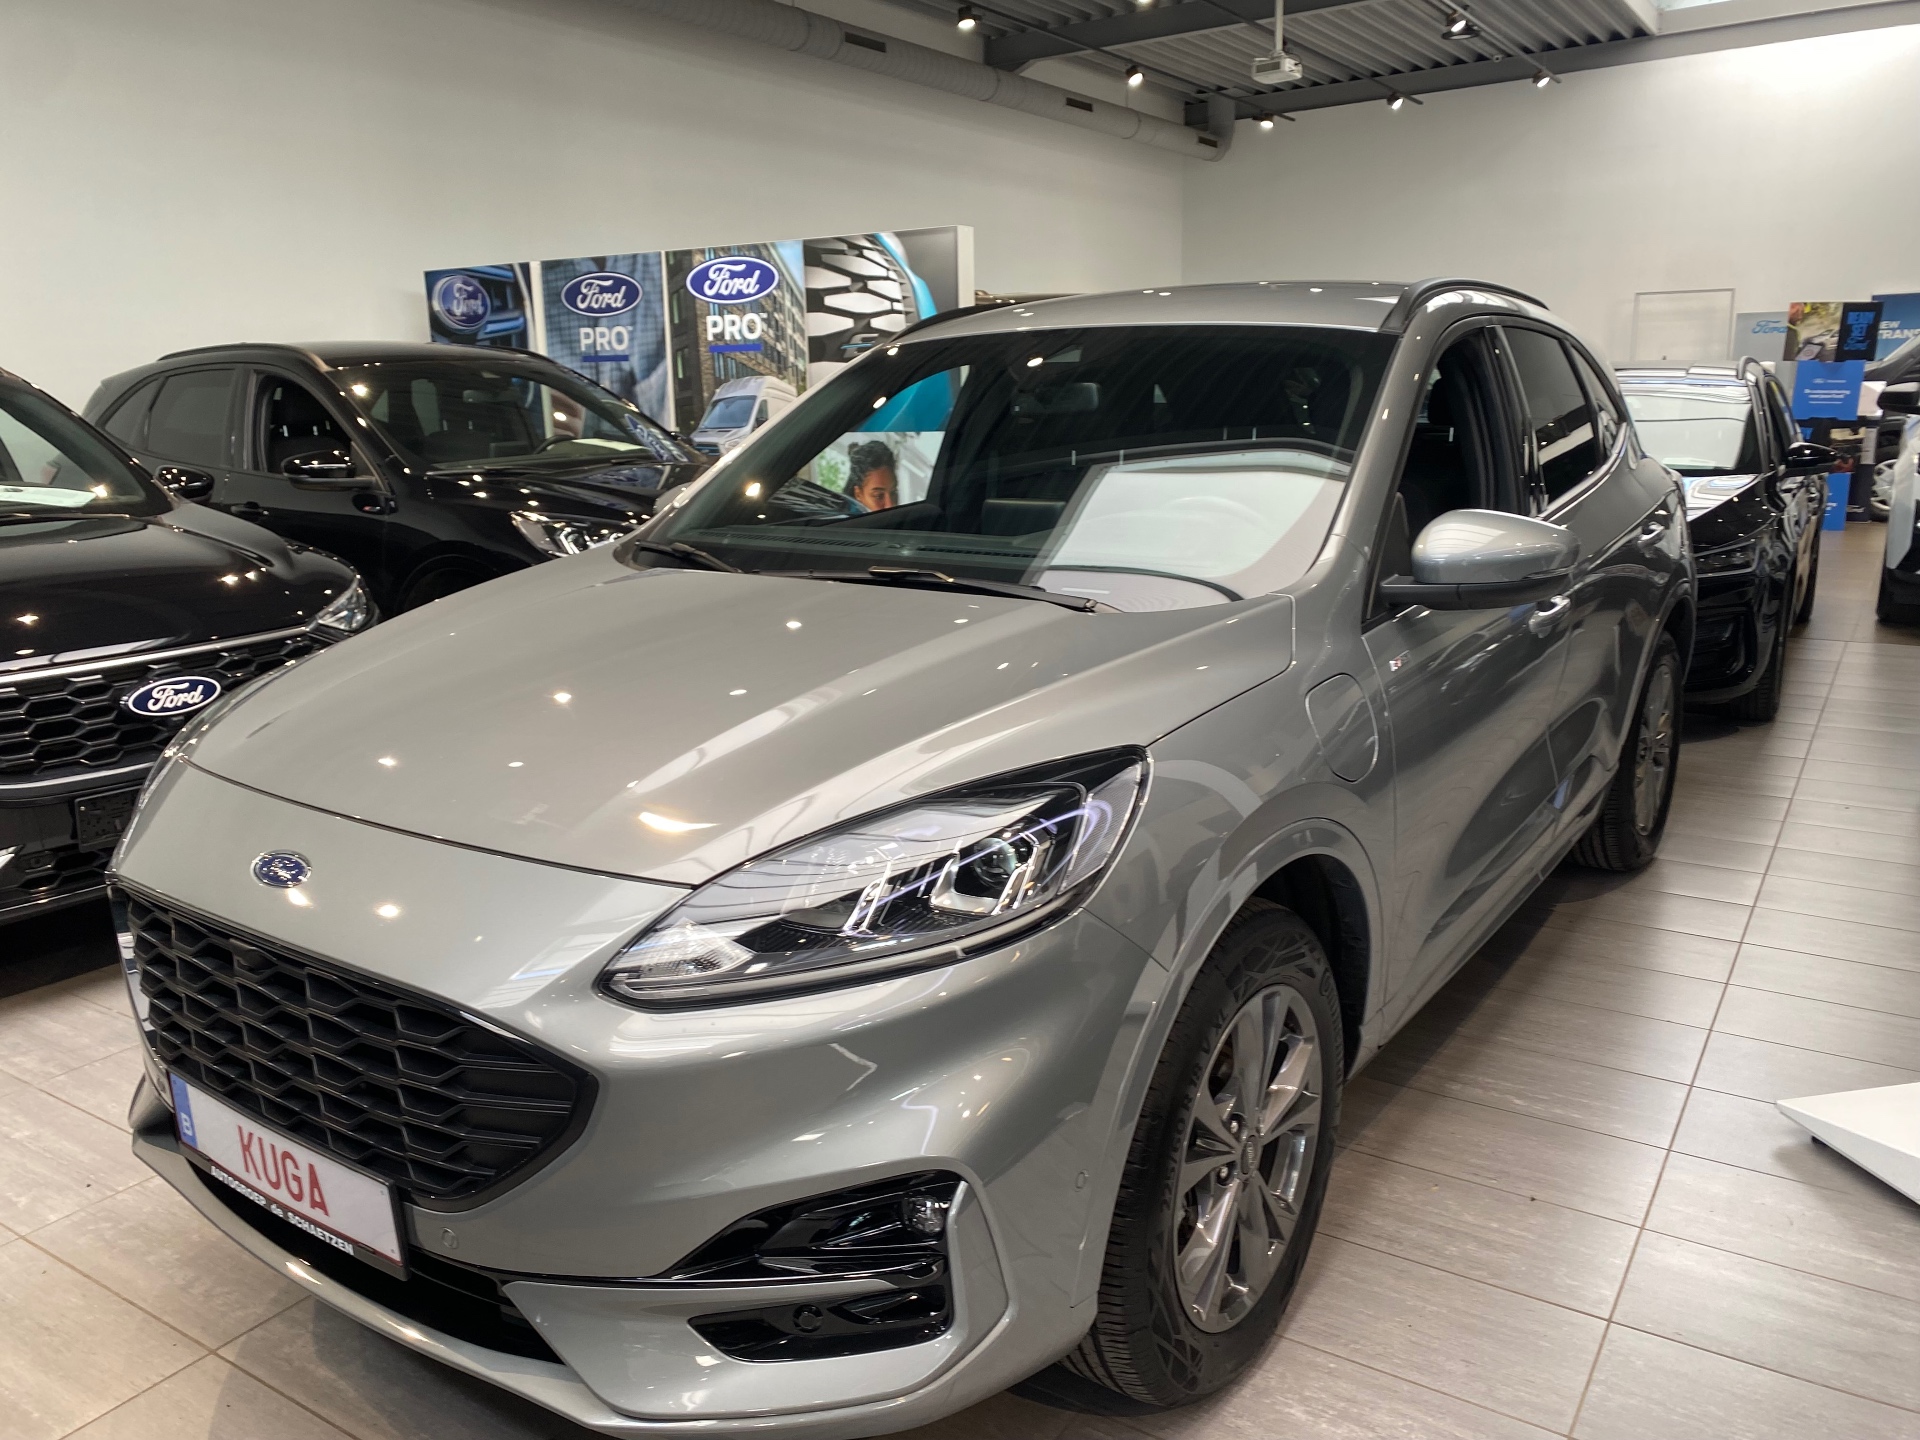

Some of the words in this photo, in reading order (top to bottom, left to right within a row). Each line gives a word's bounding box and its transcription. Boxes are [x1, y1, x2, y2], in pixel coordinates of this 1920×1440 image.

[576, 279, 627, 309] Ford
[703, 263, 761, 296] Ford
[147, 682, 204, 711] Ford
[180, 1112, 193, 1136] B
[237, 1124, 330, 1217] KUGA
[210, 1165, 267, 1206] AUTOGROEP
[270, 1203, 284, 1218] de
[287, 1212, 355, 1256] SCHAETZEN
